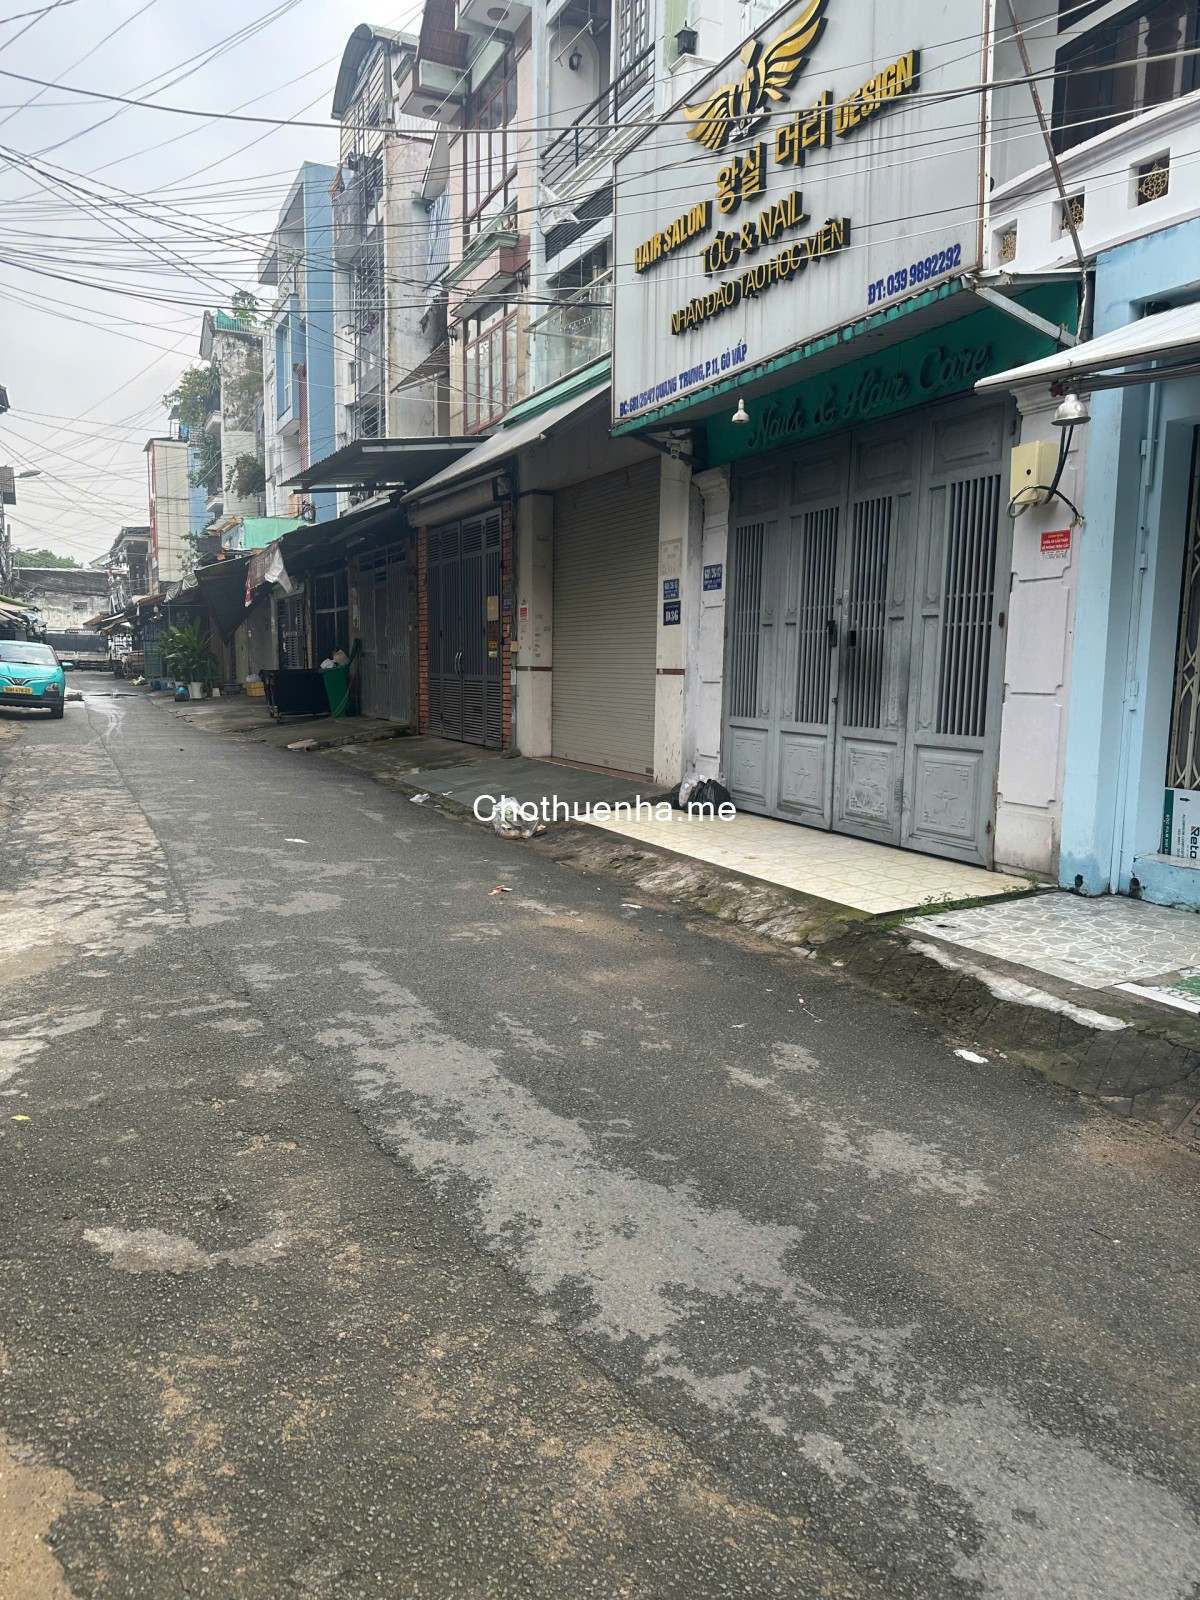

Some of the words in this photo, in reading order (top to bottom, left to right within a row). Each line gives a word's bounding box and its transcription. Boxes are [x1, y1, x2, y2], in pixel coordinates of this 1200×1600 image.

[635, 233, 664, 273] HAIR
[664, 202, 709, 252] SALON
[716, 142, 764, 214] 왕실
[775, 90, 829, 165] 머리
[835, 50, 917, 138] DESIGN
[740, 222, 757, 254] &
[759, 191, 807, 243] NAIL
[887, 268, 907, 296] 039
[909, 244, 961, 287] 9892292
[656, 376, 677, 402] QUANG
[679, 364, 705, 389] TRUNG,
[720, 347, 731, 371] GÒ
[732, 339, 747, 366] VẤP
[749, 398, 804, 448] Nails
[815, 386, 838, 426] &
[844, 369, 909, 418] Hair
[917, 345, 992, 394] Care
[666, 610, 679, 621] D36
